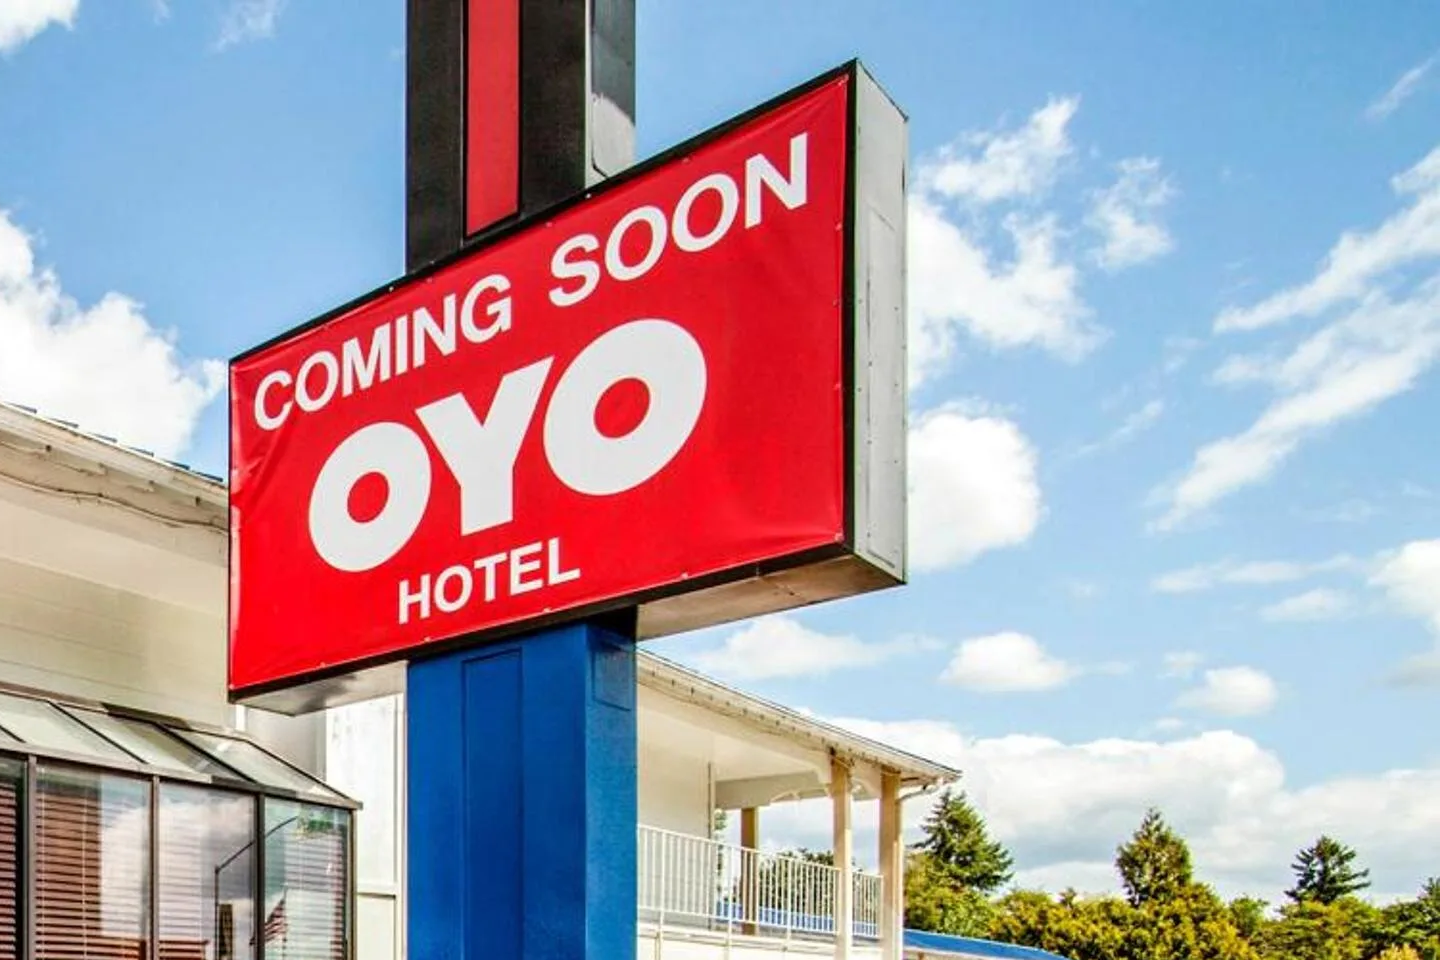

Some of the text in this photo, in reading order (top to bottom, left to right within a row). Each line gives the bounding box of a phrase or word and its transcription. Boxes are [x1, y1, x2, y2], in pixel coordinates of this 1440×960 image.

[253, 132, 808, 431] COMING SOON
[308, 318, 708, 573] OYO
[398, 537, 581, 625] HOTEL
